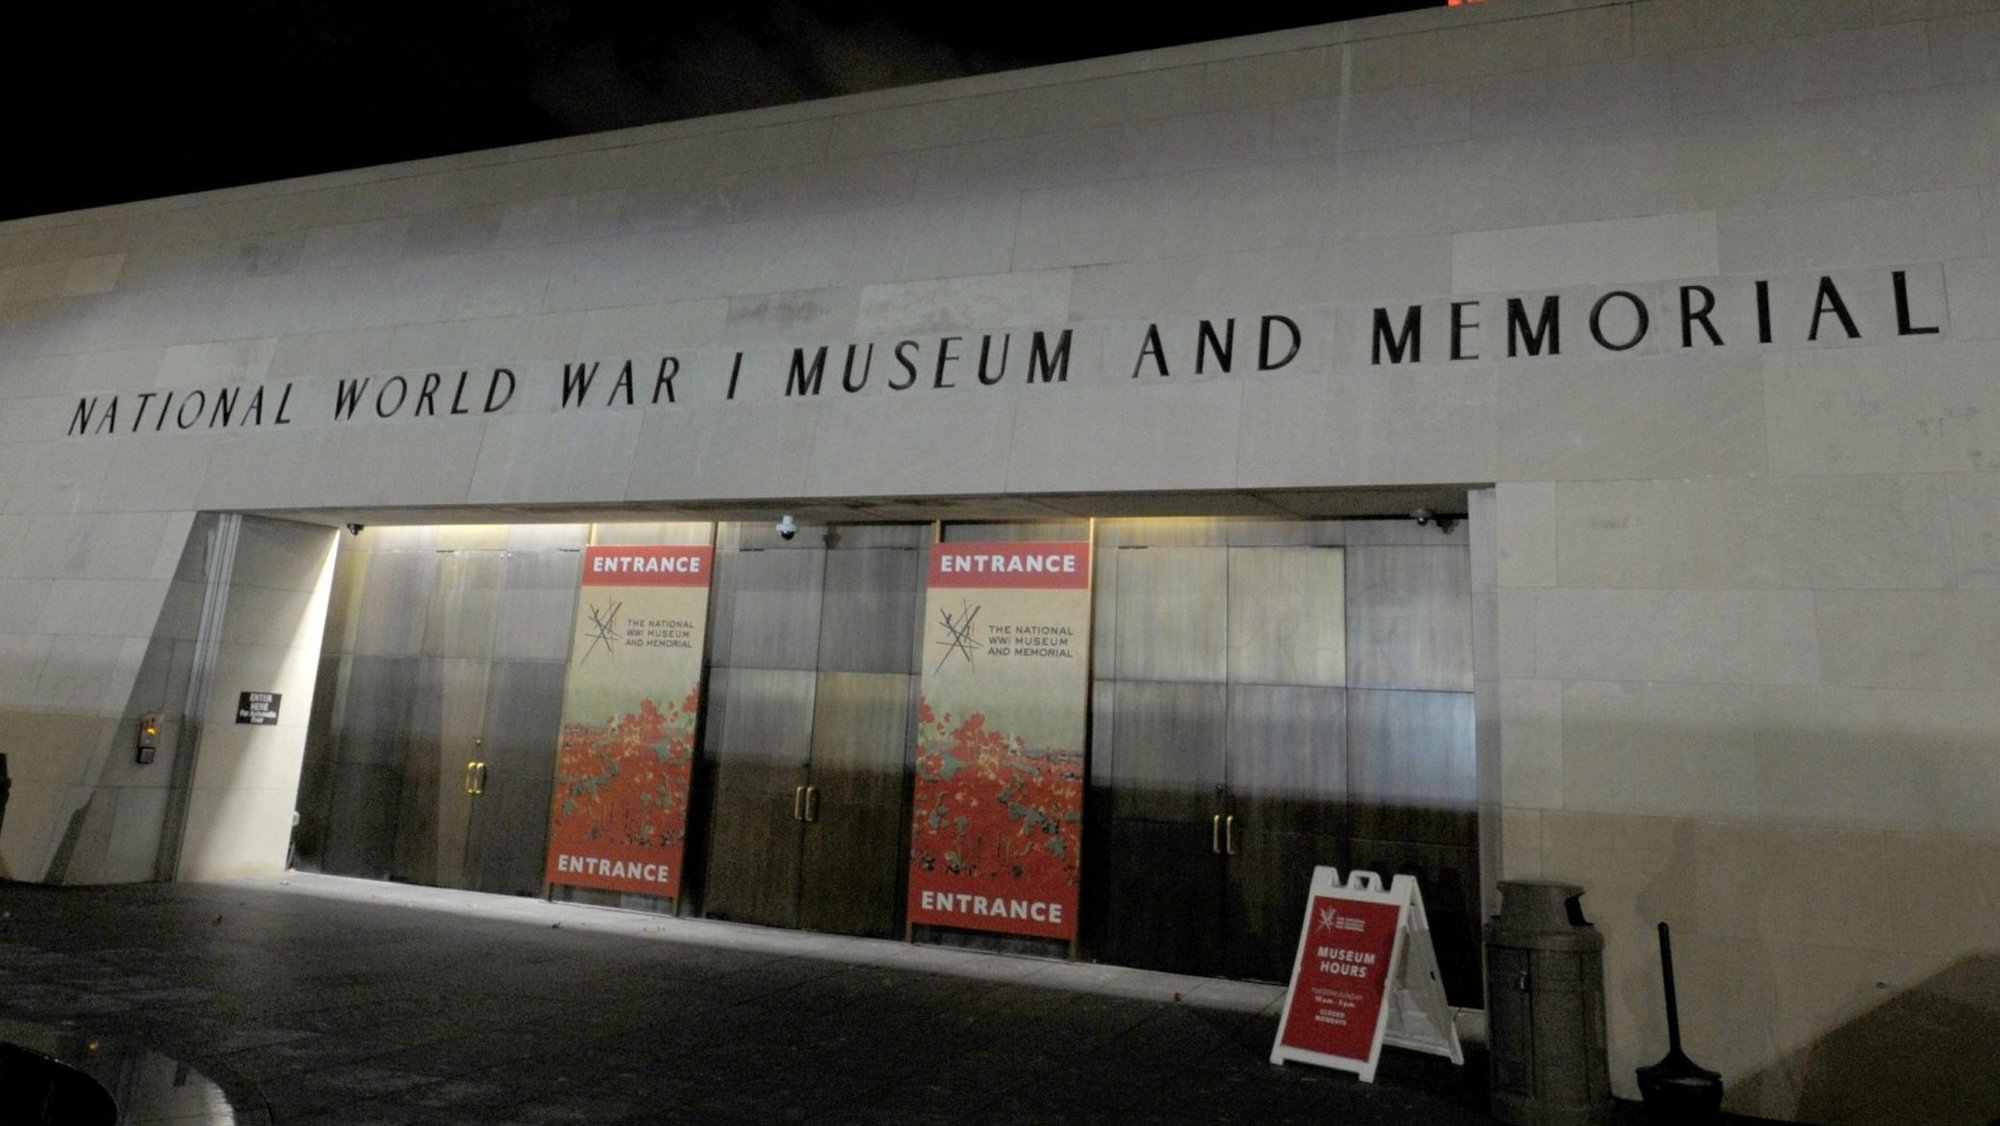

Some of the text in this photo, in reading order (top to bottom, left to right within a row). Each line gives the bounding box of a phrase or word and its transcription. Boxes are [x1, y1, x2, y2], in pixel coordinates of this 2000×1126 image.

[68, 270, 1941, 436] NATIONAL WORLD WAR I MUSEUM AND MEMORIAL
[592, 556, 701, 573] ENTRANCE
[940, 555, 1076, 573] ENTRANCE
[627, 619, 695, 629] THE NATIONAL
[988, 625, 1074, 636] THE NATIONAL
[648, 629, 690, 638] MUSEUM
[1015, 636, 1068, 646] MUSEUM
[625, 639, 692, 649] AND MEMORIAL
[988, 647, 1073, 658] AND MEMORIAL
[557, 853, 669, 883] ENTRANCE
[921, 890, 1062, 924] ENTRANCE
[1318, 946, 1375, 964] MUSEUM
[1320, 962, 1367, 978] HOURS
